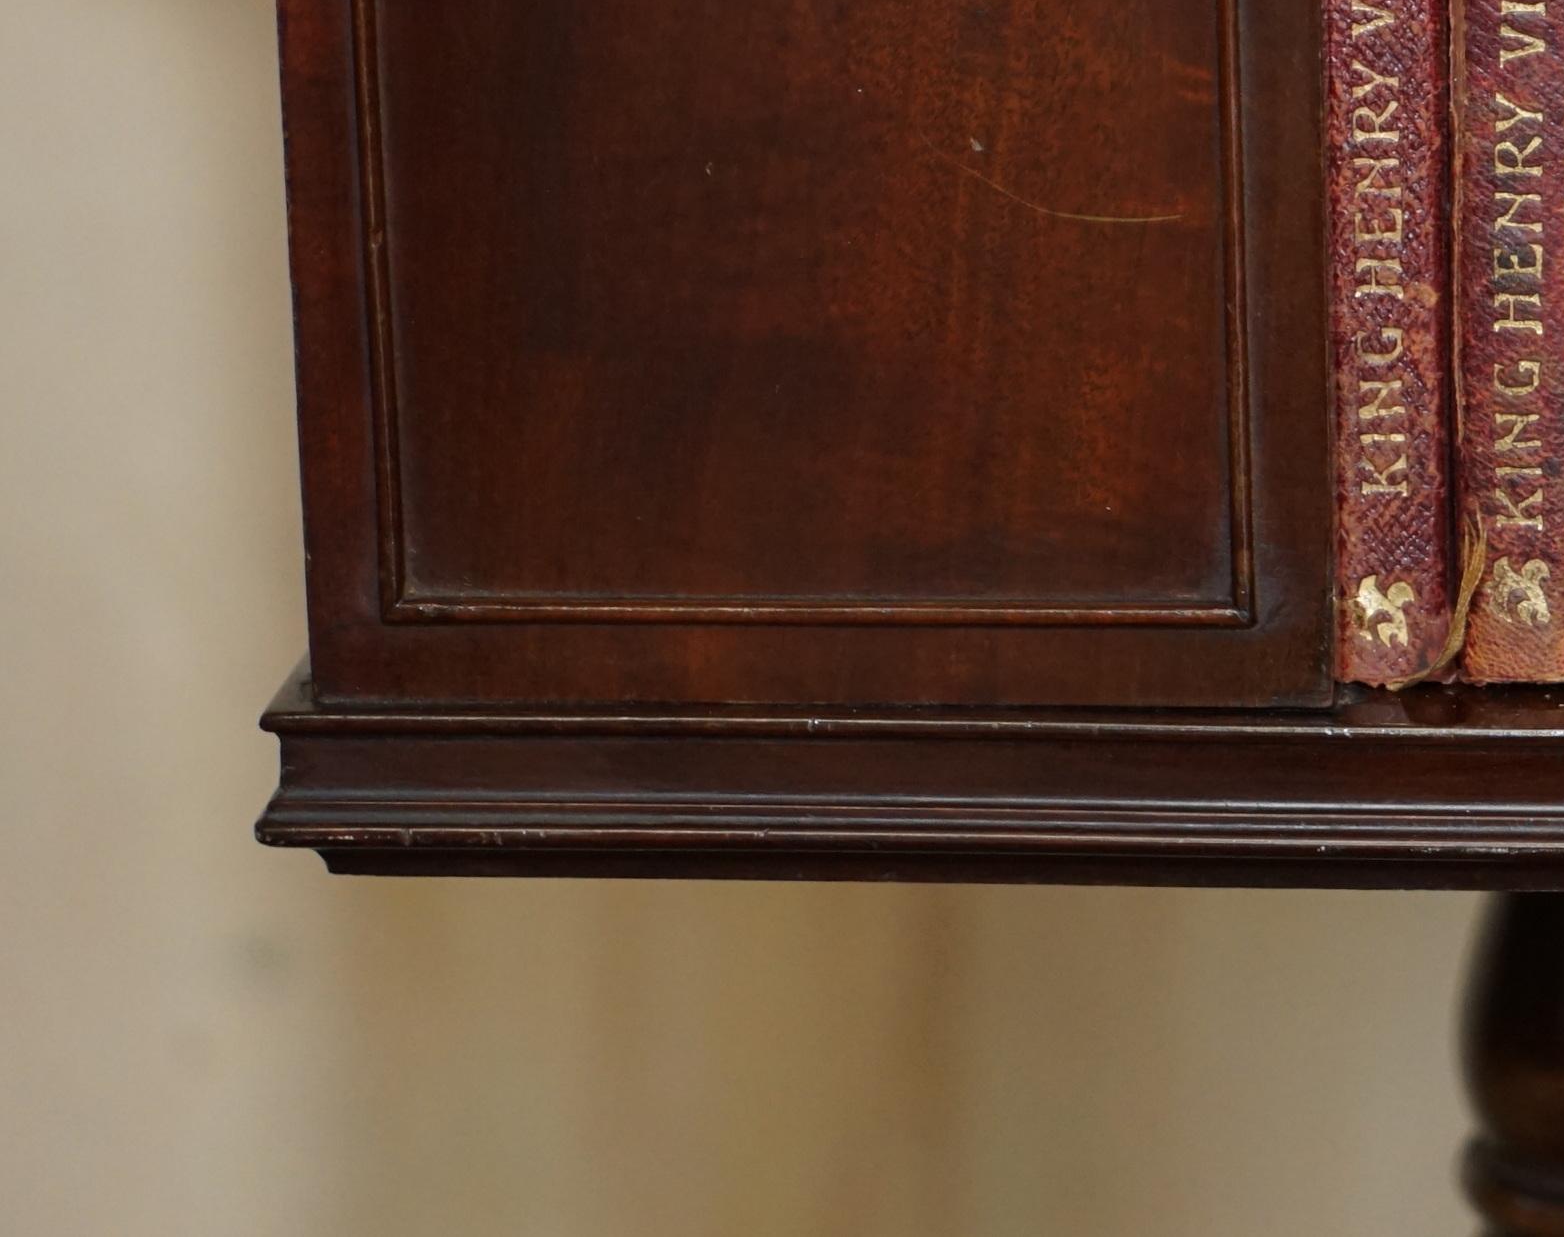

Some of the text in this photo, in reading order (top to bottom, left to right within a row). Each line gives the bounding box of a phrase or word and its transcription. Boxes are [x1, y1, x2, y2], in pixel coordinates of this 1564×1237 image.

[1351, 58, 1404, 296] HENRY
[1493, 91, 1545, 335] HENRY
[1356, 325, 1408, 498] KING
[1493, 358, 1544, 531] KING
